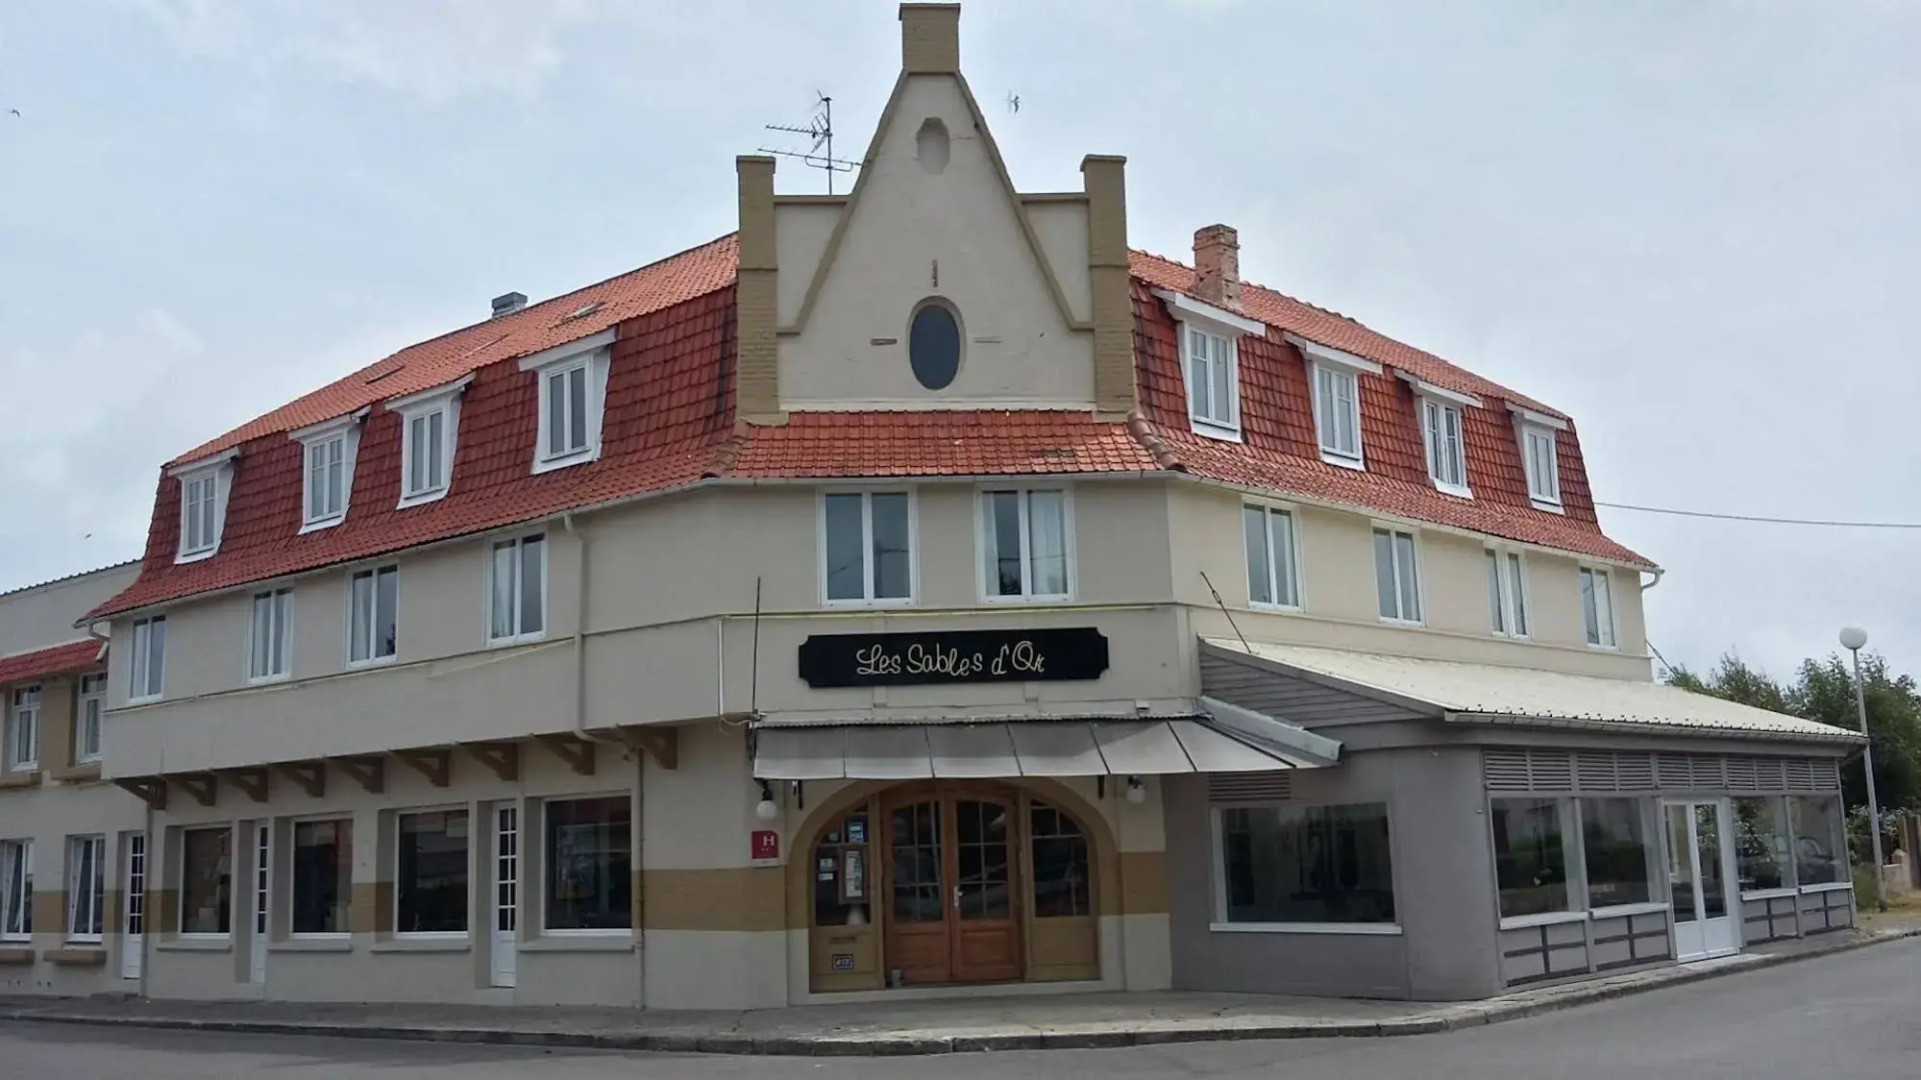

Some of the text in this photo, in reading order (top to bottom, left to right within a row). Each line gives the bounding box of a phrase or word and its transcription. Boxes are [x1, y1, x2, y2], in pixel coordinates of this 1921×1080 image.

[856, 640, 1046, 677] Les Sables d'Or
[763, 835, 775, 847] H
